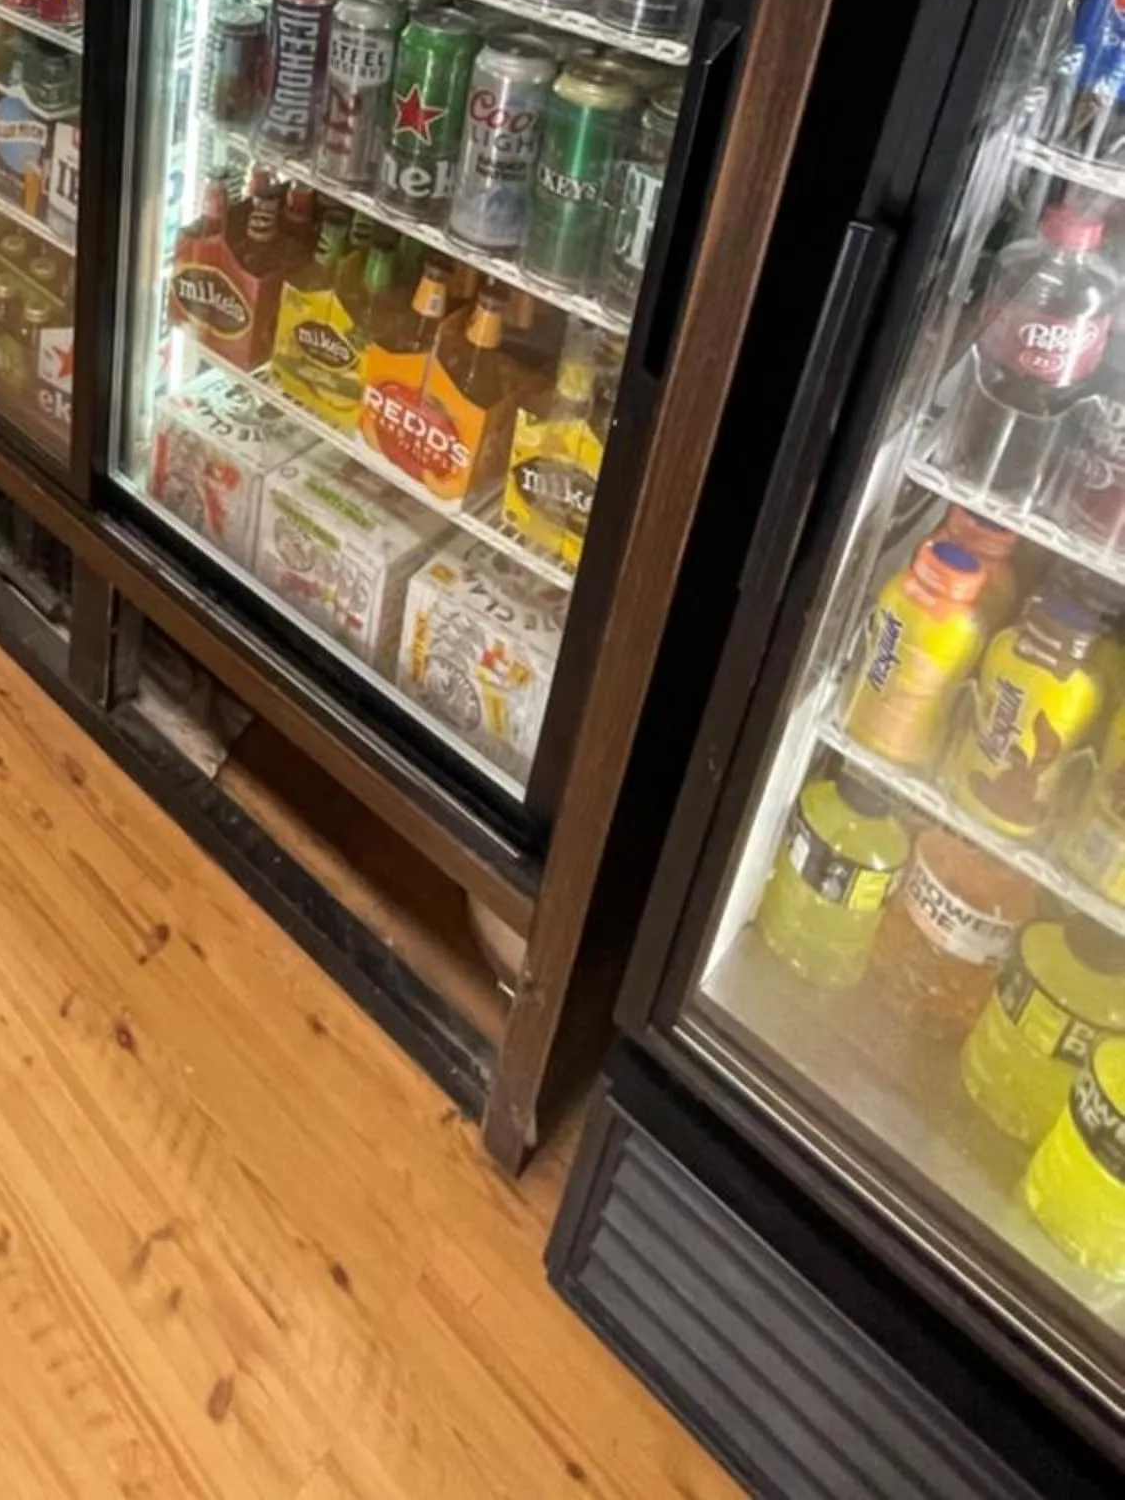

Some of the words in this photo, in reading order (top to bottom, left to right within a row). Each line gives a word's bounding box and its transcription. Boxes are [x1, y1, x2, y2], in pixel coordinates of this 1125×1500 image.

[261, 5, 322, 141] ICEHOUSE
[331, 40, 387, 68] STEEL
[471, 124, 536, 155] LIGH
[363, 384, 472, 469] REDD'S
